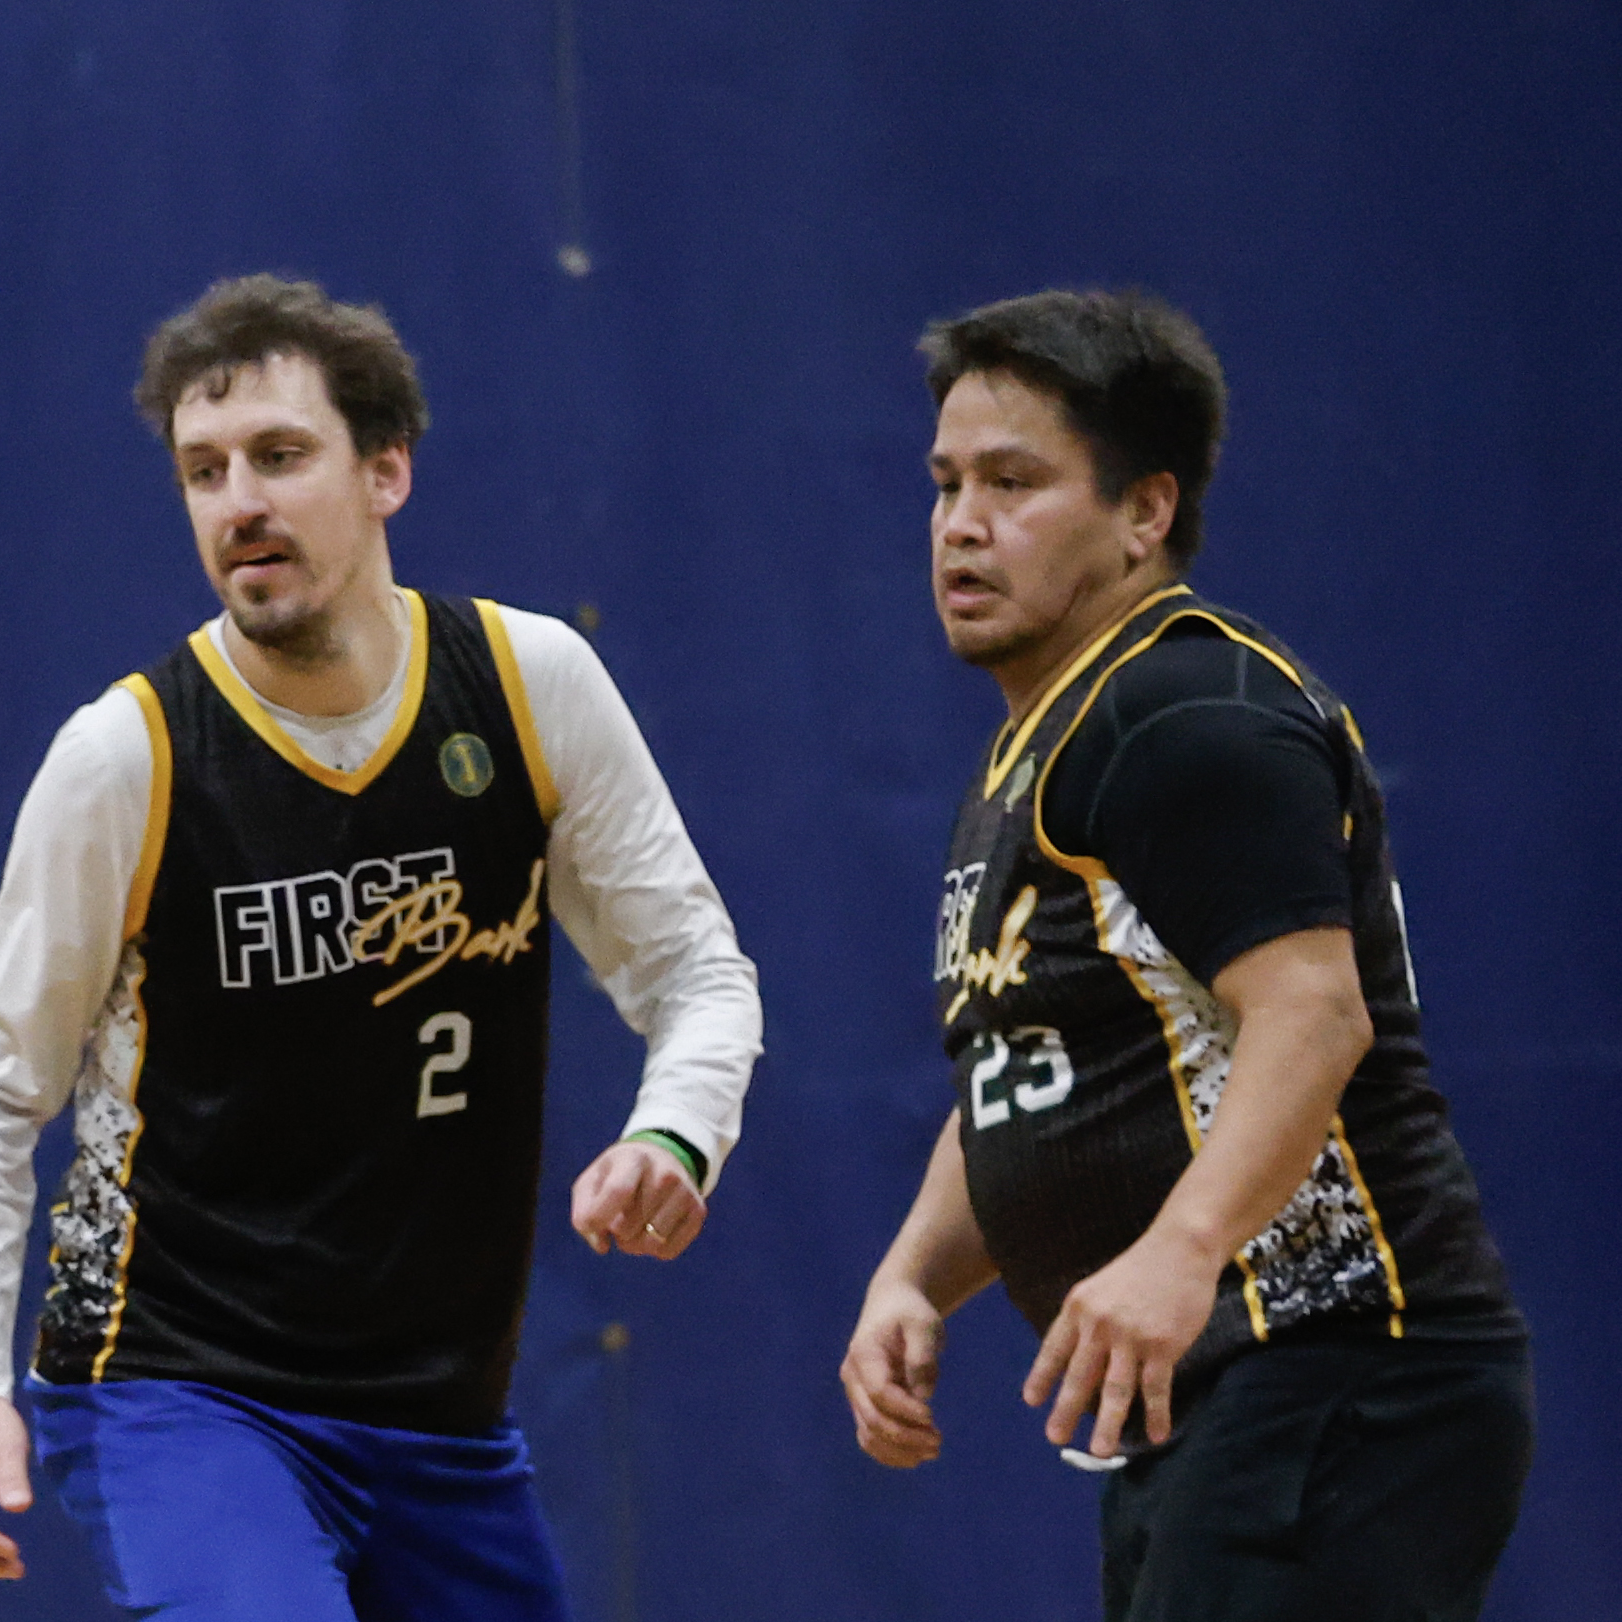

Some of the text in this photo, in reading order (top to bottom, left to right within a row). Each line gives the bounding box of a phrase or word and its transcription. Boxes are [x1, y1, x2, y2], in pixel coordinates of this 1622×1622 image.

[213, 846, 546, 1008] FIRST Bank
[416, 1010, 473, 1119] 2
[970, 1025, 1074, 1130] 23
